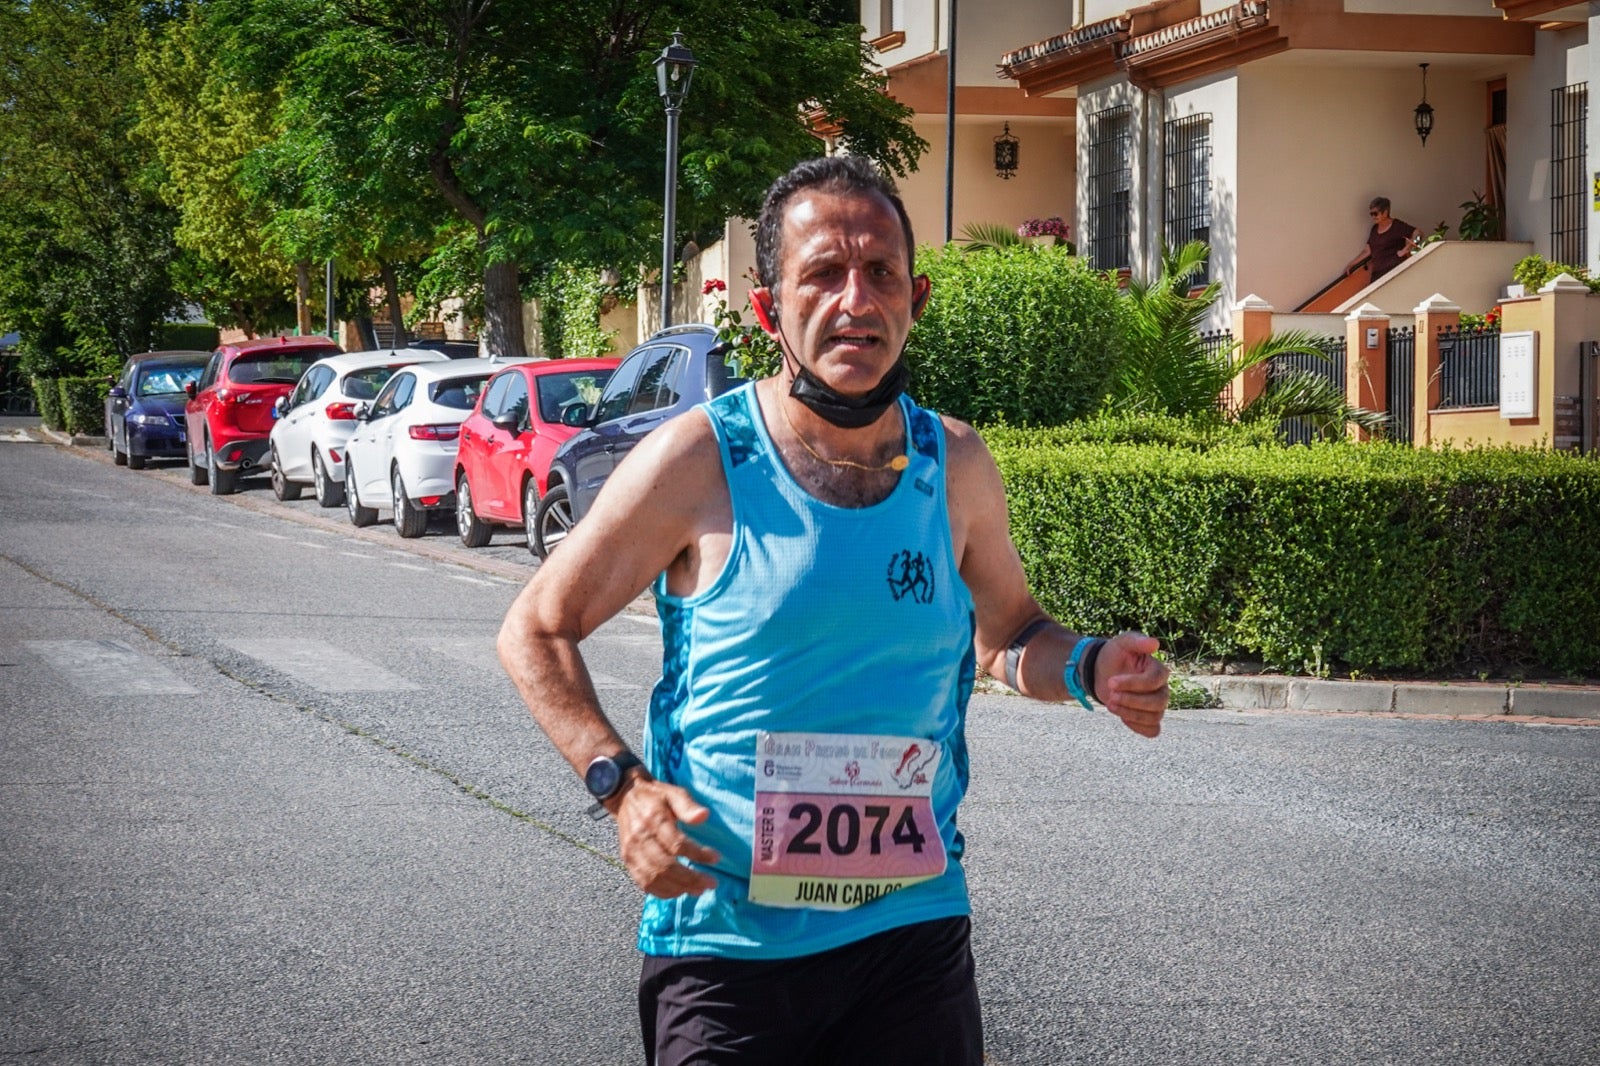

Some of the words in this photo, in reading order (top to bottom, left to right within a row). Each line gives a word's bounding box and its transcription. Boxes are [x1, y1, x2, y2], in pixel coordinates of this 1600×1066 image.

[762, 807, 775, 815] B
[761, 817, 775, 862] MASTER
[785, 802, 926, 856] 2074
[794, 881, 838, 904] JUAN
